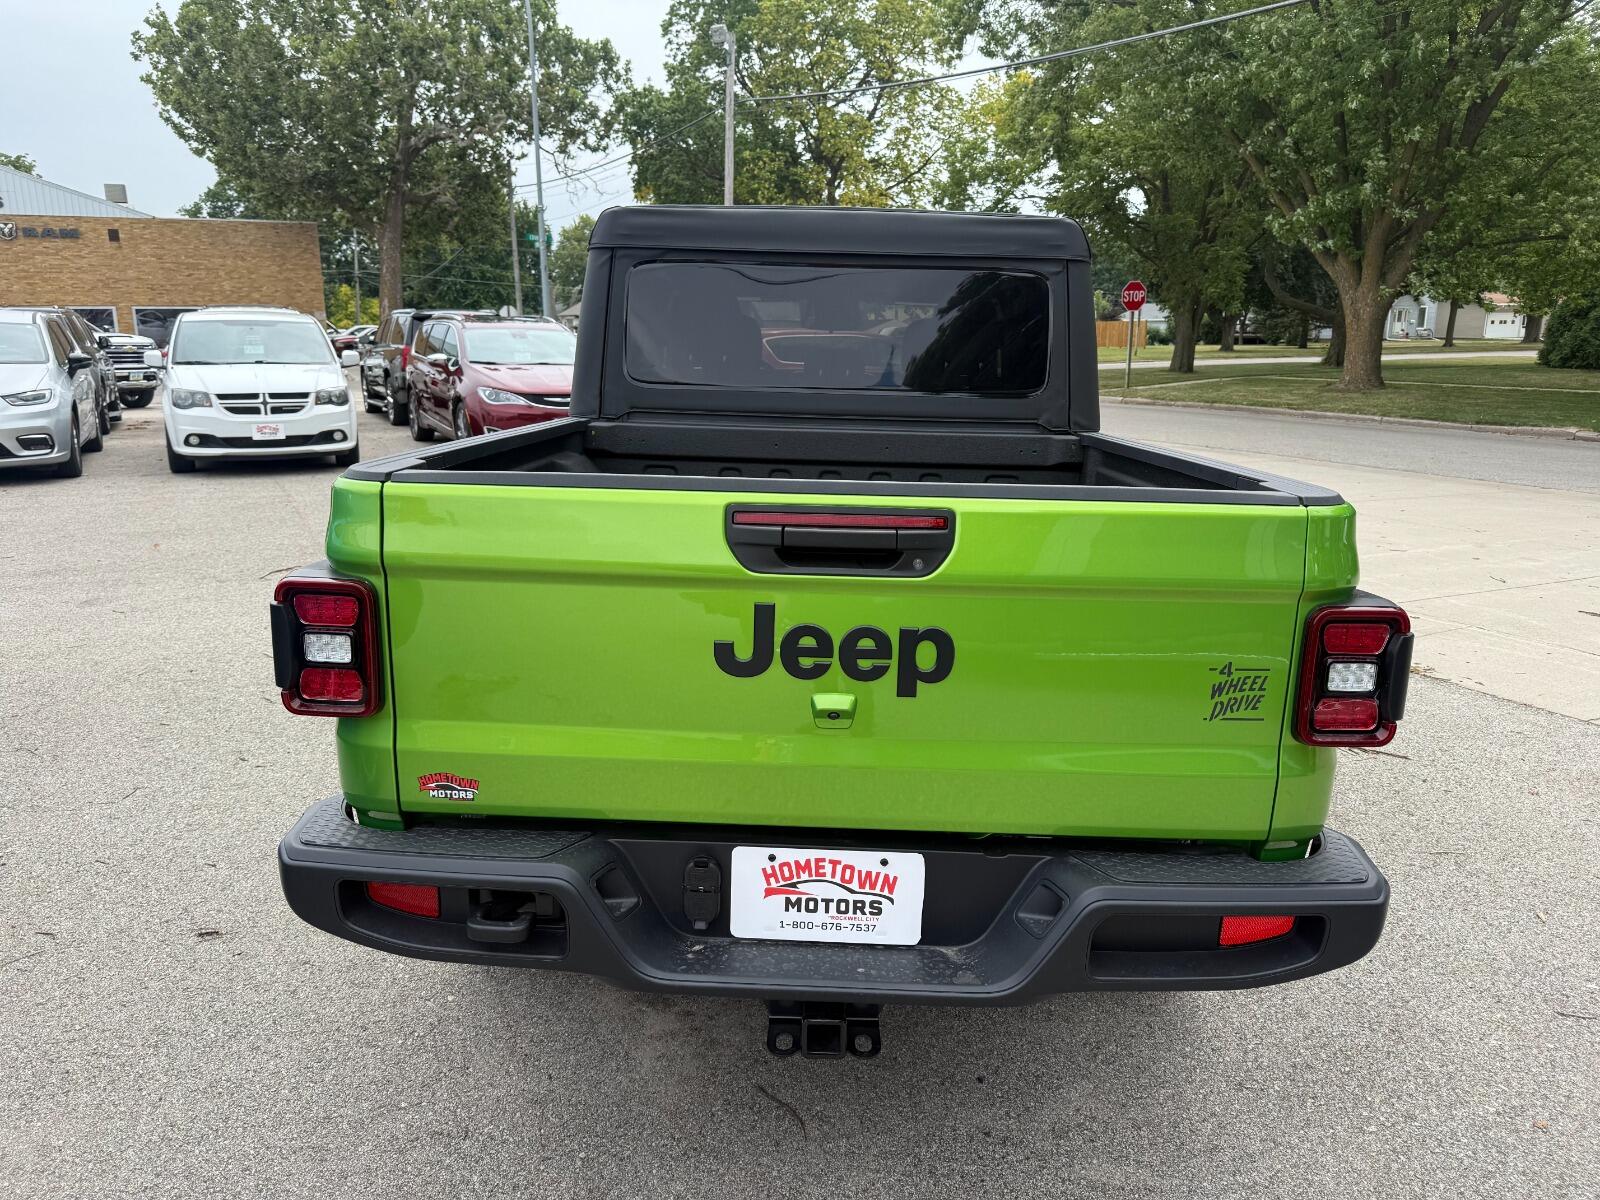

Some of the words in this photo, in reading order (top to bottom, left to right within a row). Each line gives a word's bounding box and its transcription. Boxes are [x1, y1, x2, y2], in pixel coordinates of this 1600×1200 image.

[22, 227, 80, 238] RAM
[1123, 290, 1145, 302] STOP
[713, 601, 955, 697] Jeep
[1219, 661, 1233, 677] 4
[1211, 675, 1268, 700] WHEEL
[1209, 694, 1265, 721] DRIVE
[418, 773, 479, 790] HOMETOWN
[429, 790, 474, 799] MOTORS
[761, 857, 898, 895] HOMETOWN
[784, 896, 883, 916] MOTORS
[779, 920, 877, 932] 1-800-676-7537
